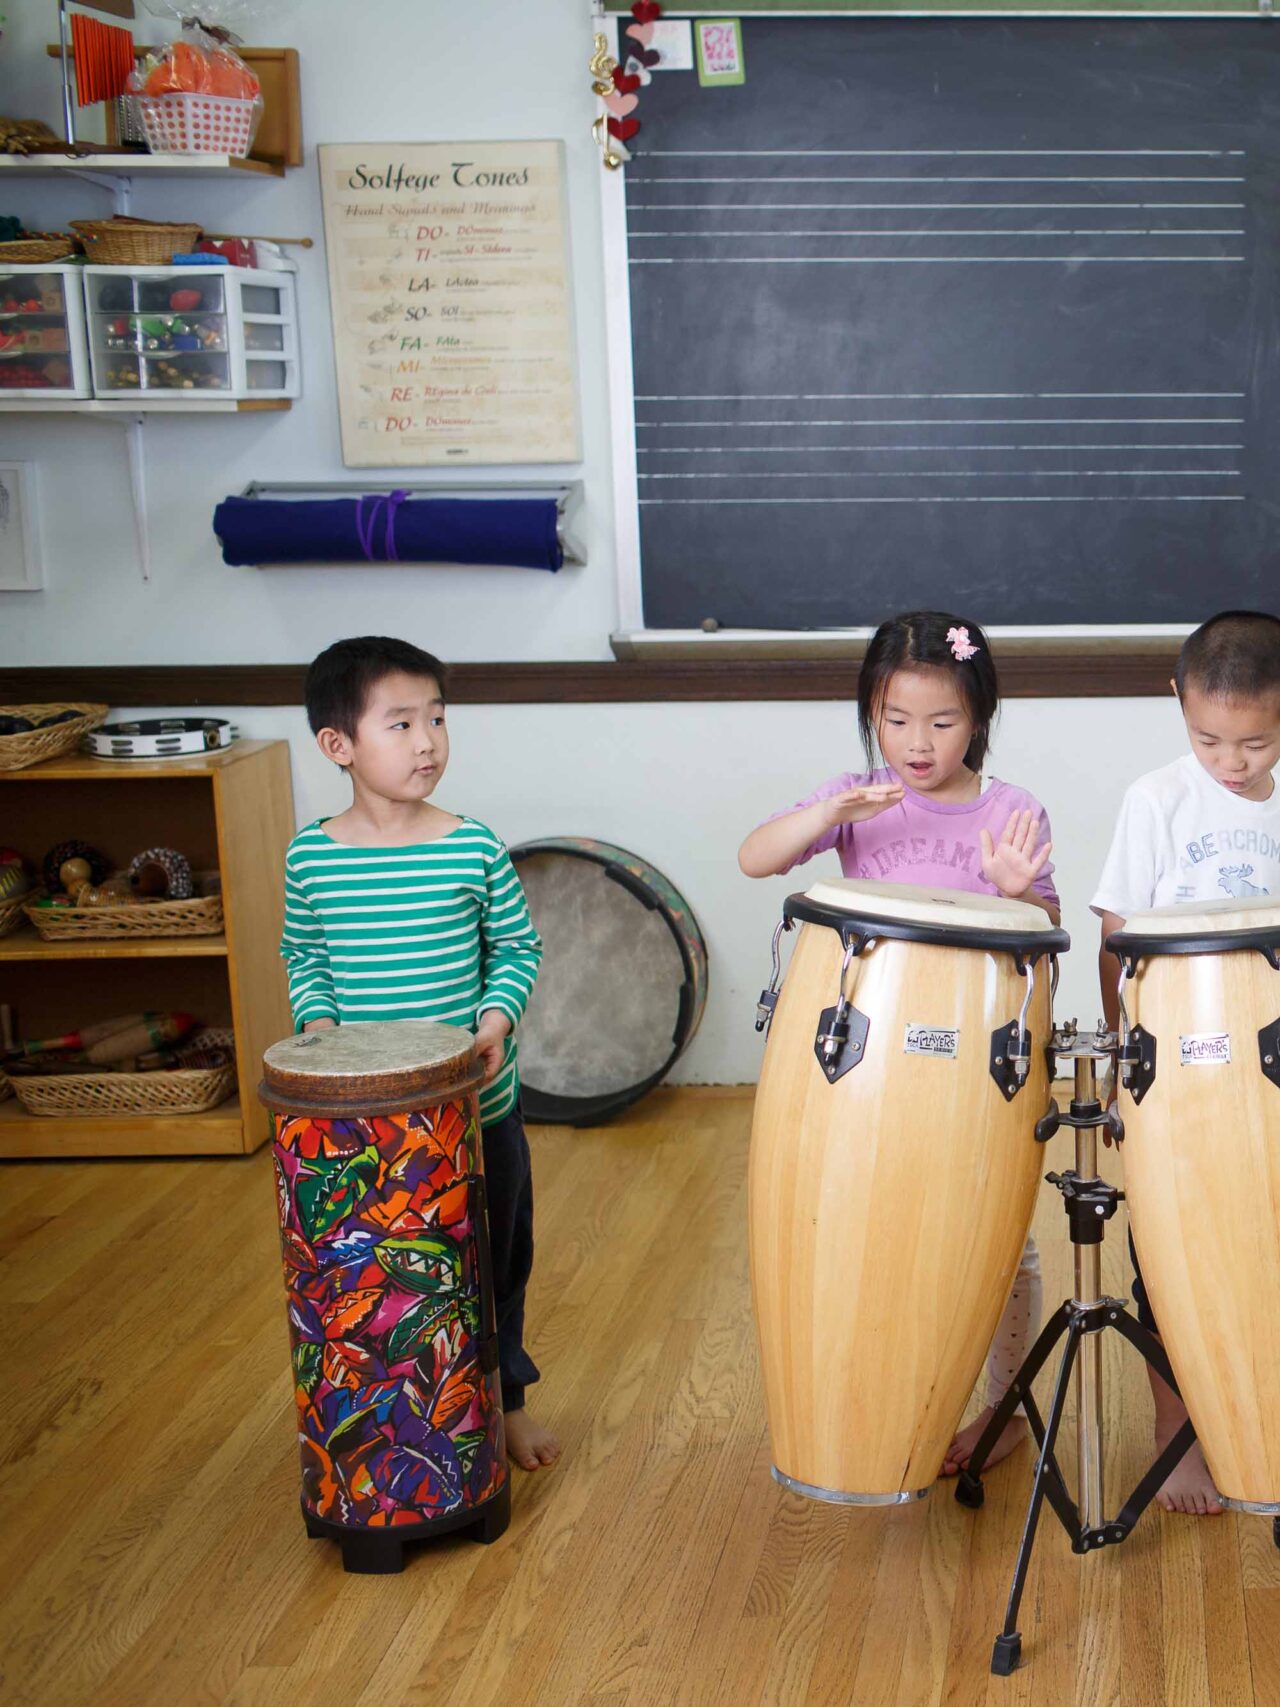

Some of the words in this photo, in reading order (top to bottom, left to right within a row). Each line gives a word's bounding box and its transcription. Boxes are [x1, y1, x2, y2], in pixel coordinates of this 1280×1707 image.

[348, 163, 440, 193] Solfege
[451, 161, 529, 188] Tones
[872, 837, 976, 878] DREAM
